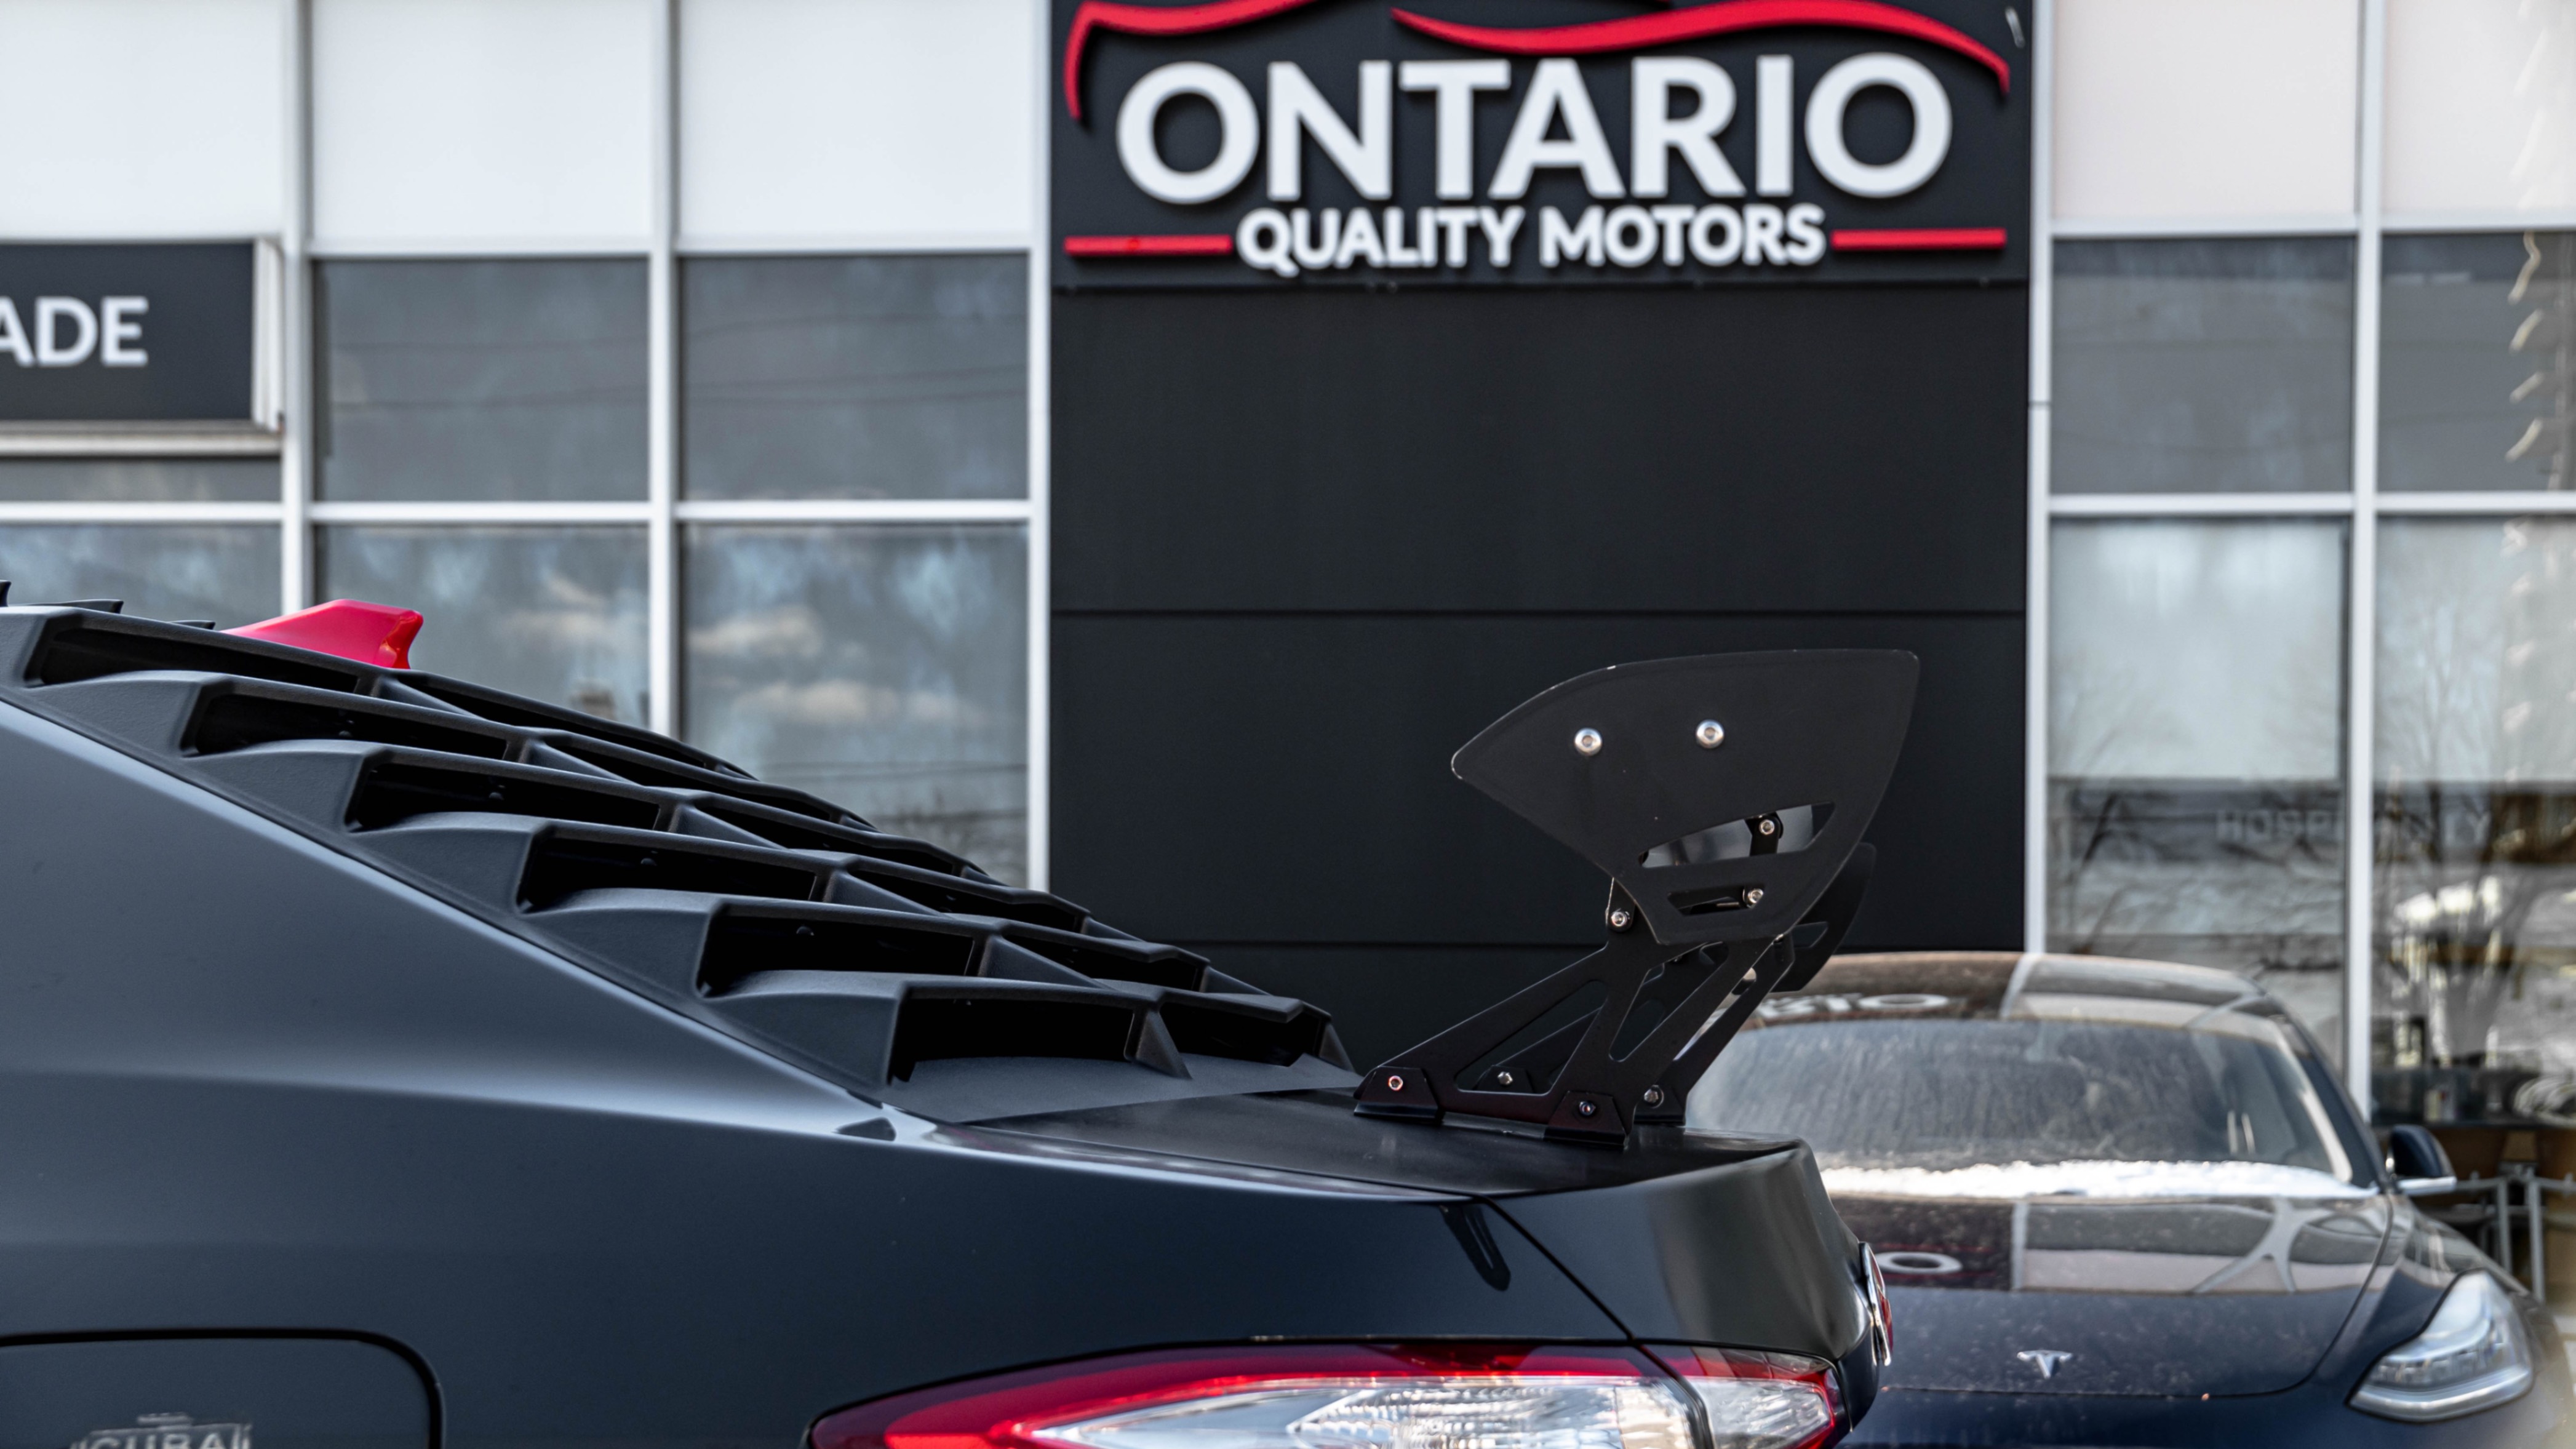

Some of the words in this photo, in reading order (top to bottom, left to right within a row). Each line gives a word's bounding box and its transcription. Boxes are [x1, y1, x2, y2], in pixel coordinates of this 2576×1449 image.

[1117, 54, 1952, 204] ONTARIO
[1237, 207, 1524, 276] QUALITY
[1541, 204, 1824, 265] MOTORS
[0, 297, 148, 365] ADE
